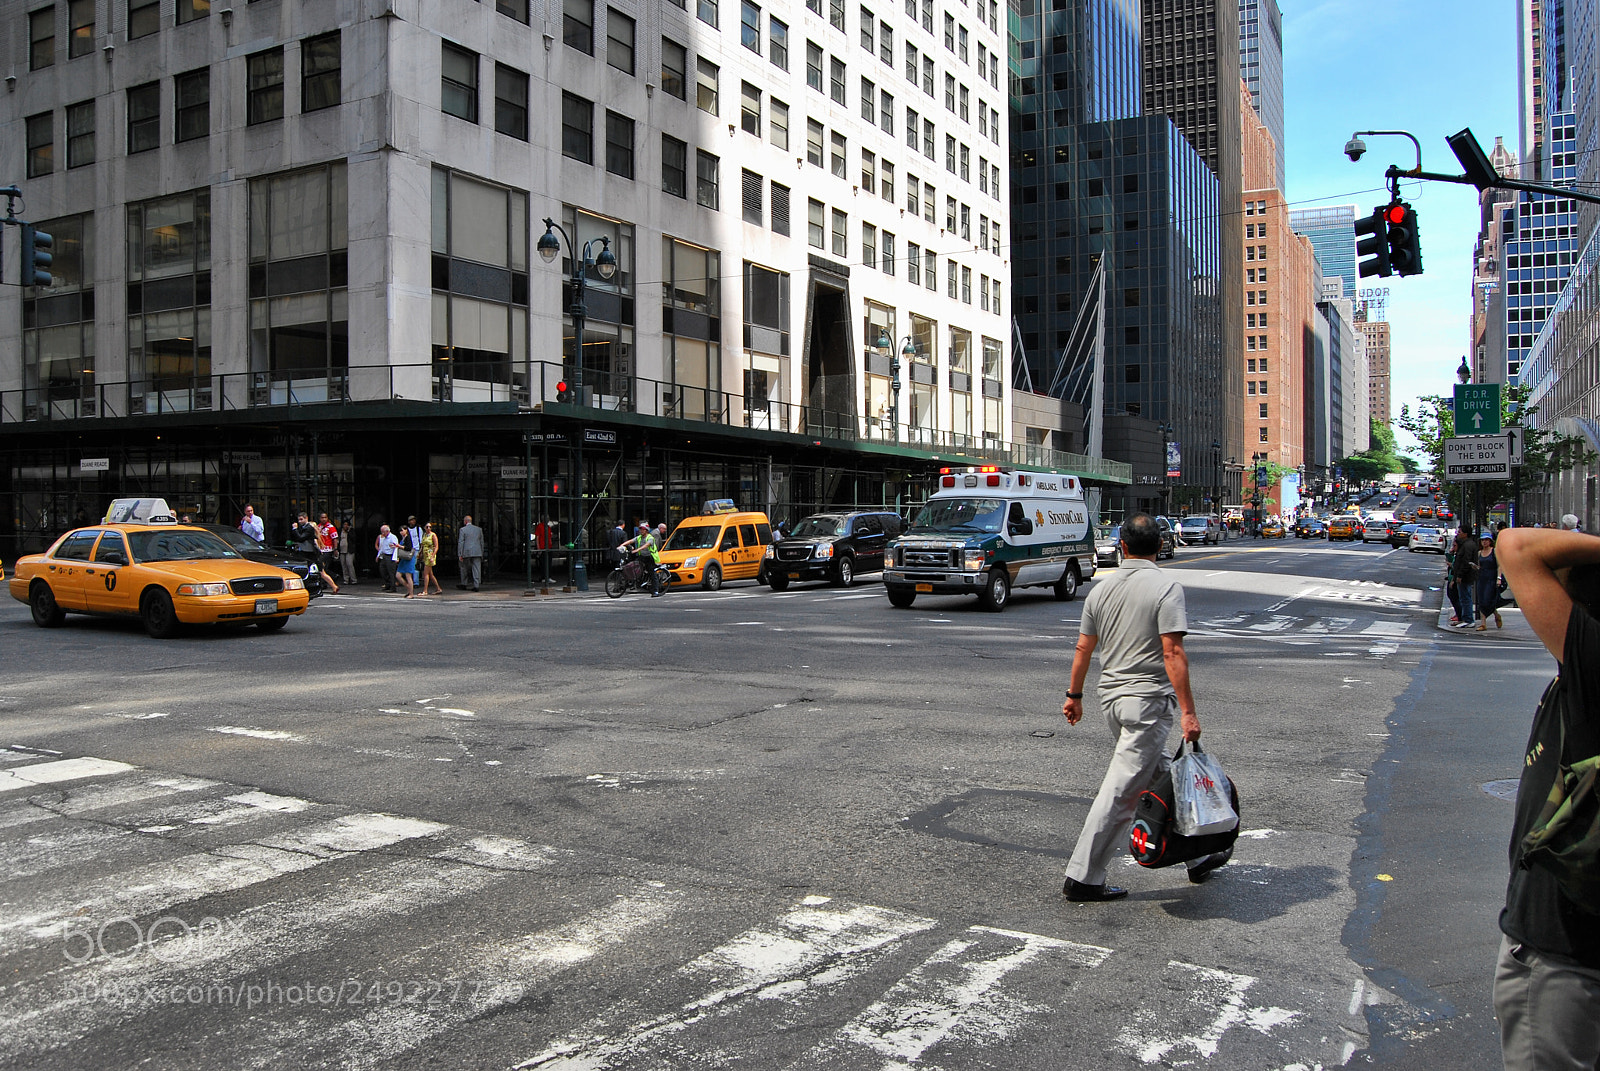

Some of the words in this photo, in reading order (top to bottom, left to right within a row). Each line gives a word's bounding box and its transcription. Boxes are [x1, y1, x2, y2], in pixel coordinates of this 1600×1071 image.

[1463, 400, 1491, 410] DRIVE
[523, 433, 555, 442] Lxingon
[586, 431, 597, 440] East
[597, 433, 609, 441] 42nd
[1448, 443, 1473, 452] DON'T
[1476, 442, 1505, 451] BLOCK
[1458, 452, 1475, 460] THE
[1478, 451, 1496, 459] BOX
[80, 460, 95, 470] DUANE
[1449, 465, 1466, 474] FINE
[1473, 465, 1479, 473] 2
[1479, 464, 1505, 473] POINTS
[1035, 481, 1058, 492] AMBULANCE
[1041, 546, 1062, 556] EMERGENCY
